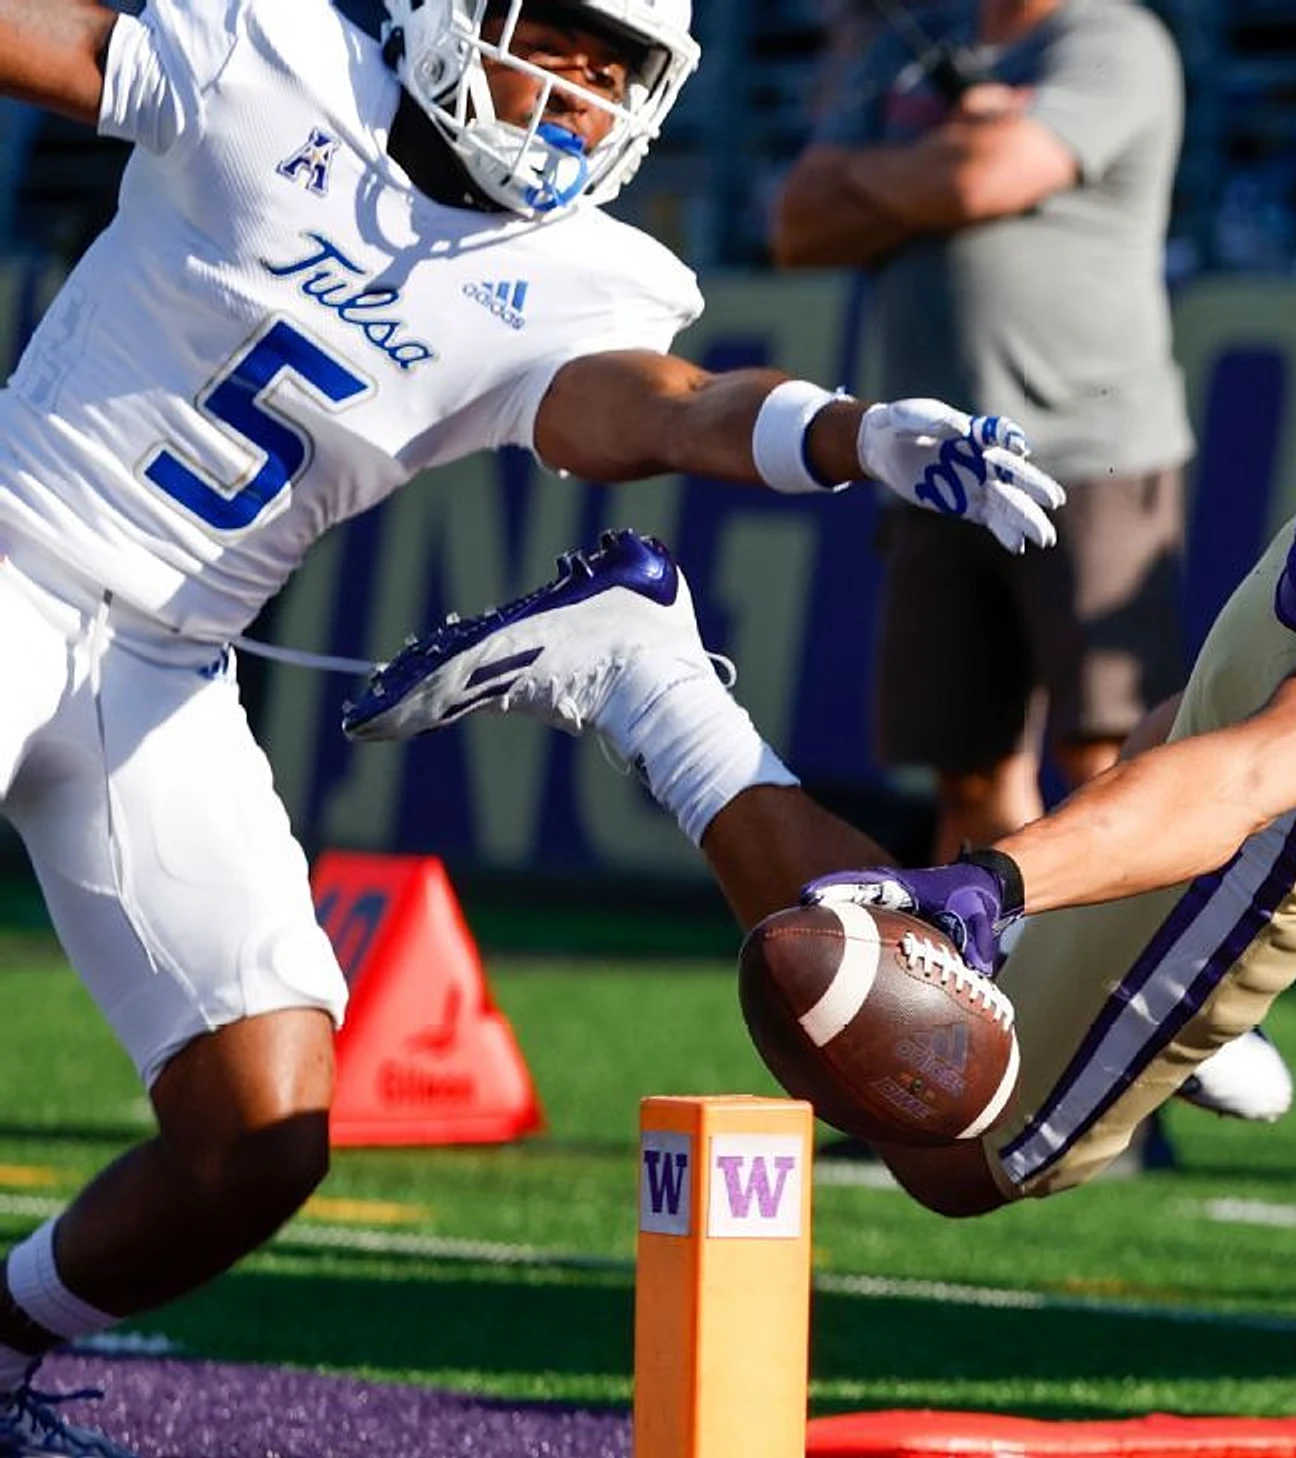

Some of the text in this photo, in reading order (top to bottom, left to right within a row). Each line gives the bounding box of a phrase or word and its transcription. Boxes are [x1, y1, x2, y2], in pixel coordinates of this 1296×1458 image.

[259, 231, 433, 369] Tulsa
[462, 281, 526, 331] adidas
[138, 315, 374, 538] 5
[643, 1150, 689, 1215] W
[717, 1156, 796, 1218] W
